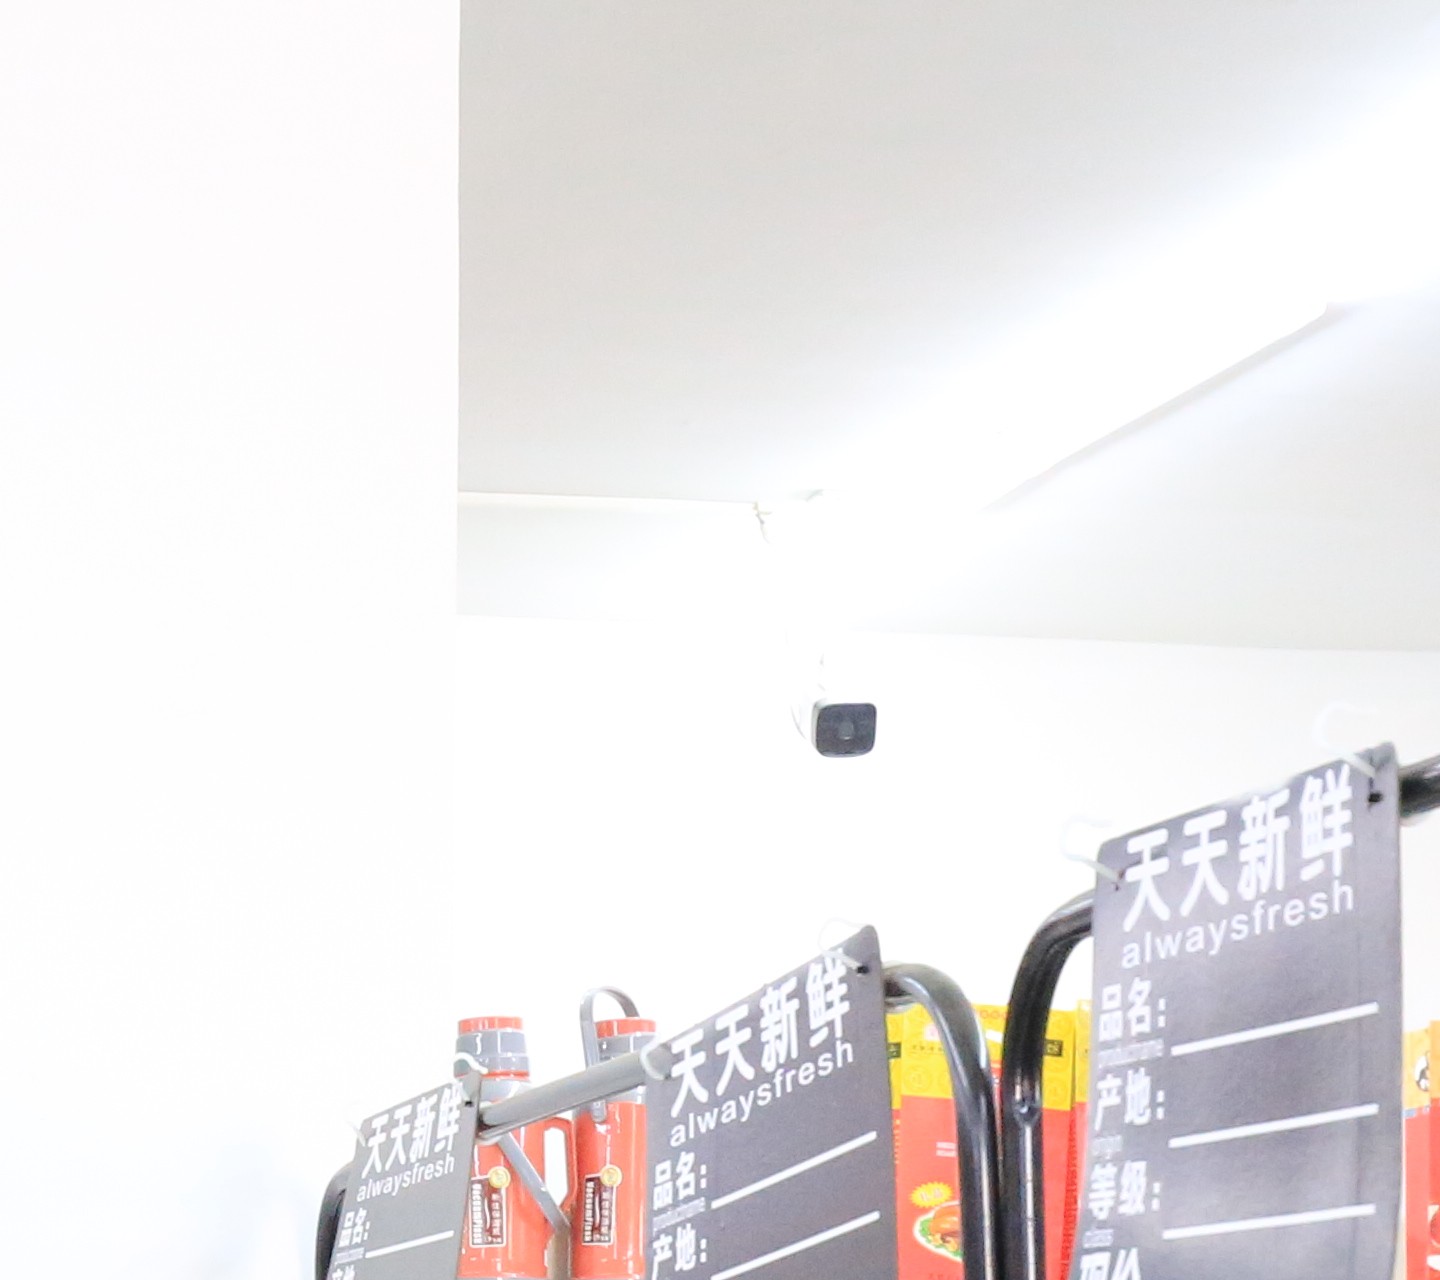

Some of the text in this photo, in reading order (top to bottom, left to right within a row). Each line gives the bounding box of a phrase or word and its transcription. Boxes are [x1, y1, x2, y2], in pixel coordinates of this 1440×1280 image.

[1122, 763, 1354, 932] 天天新鲜
[1121, 880, 1354, 969] alwaysfresh
[671, 949, 851, 1118] 天天新鲜
[1098, 977, 1166, 1042] 品名：
[361, 1081, 464, 1179] 天天新鲜
[670, 1039, 854, 1148] alwaysfresh
[1094, 1067, 1165, 1131] 产地：
[356, 1152, 456, 1202] alwaysfresh
[653, 1151, 707, 1210] 品名：
